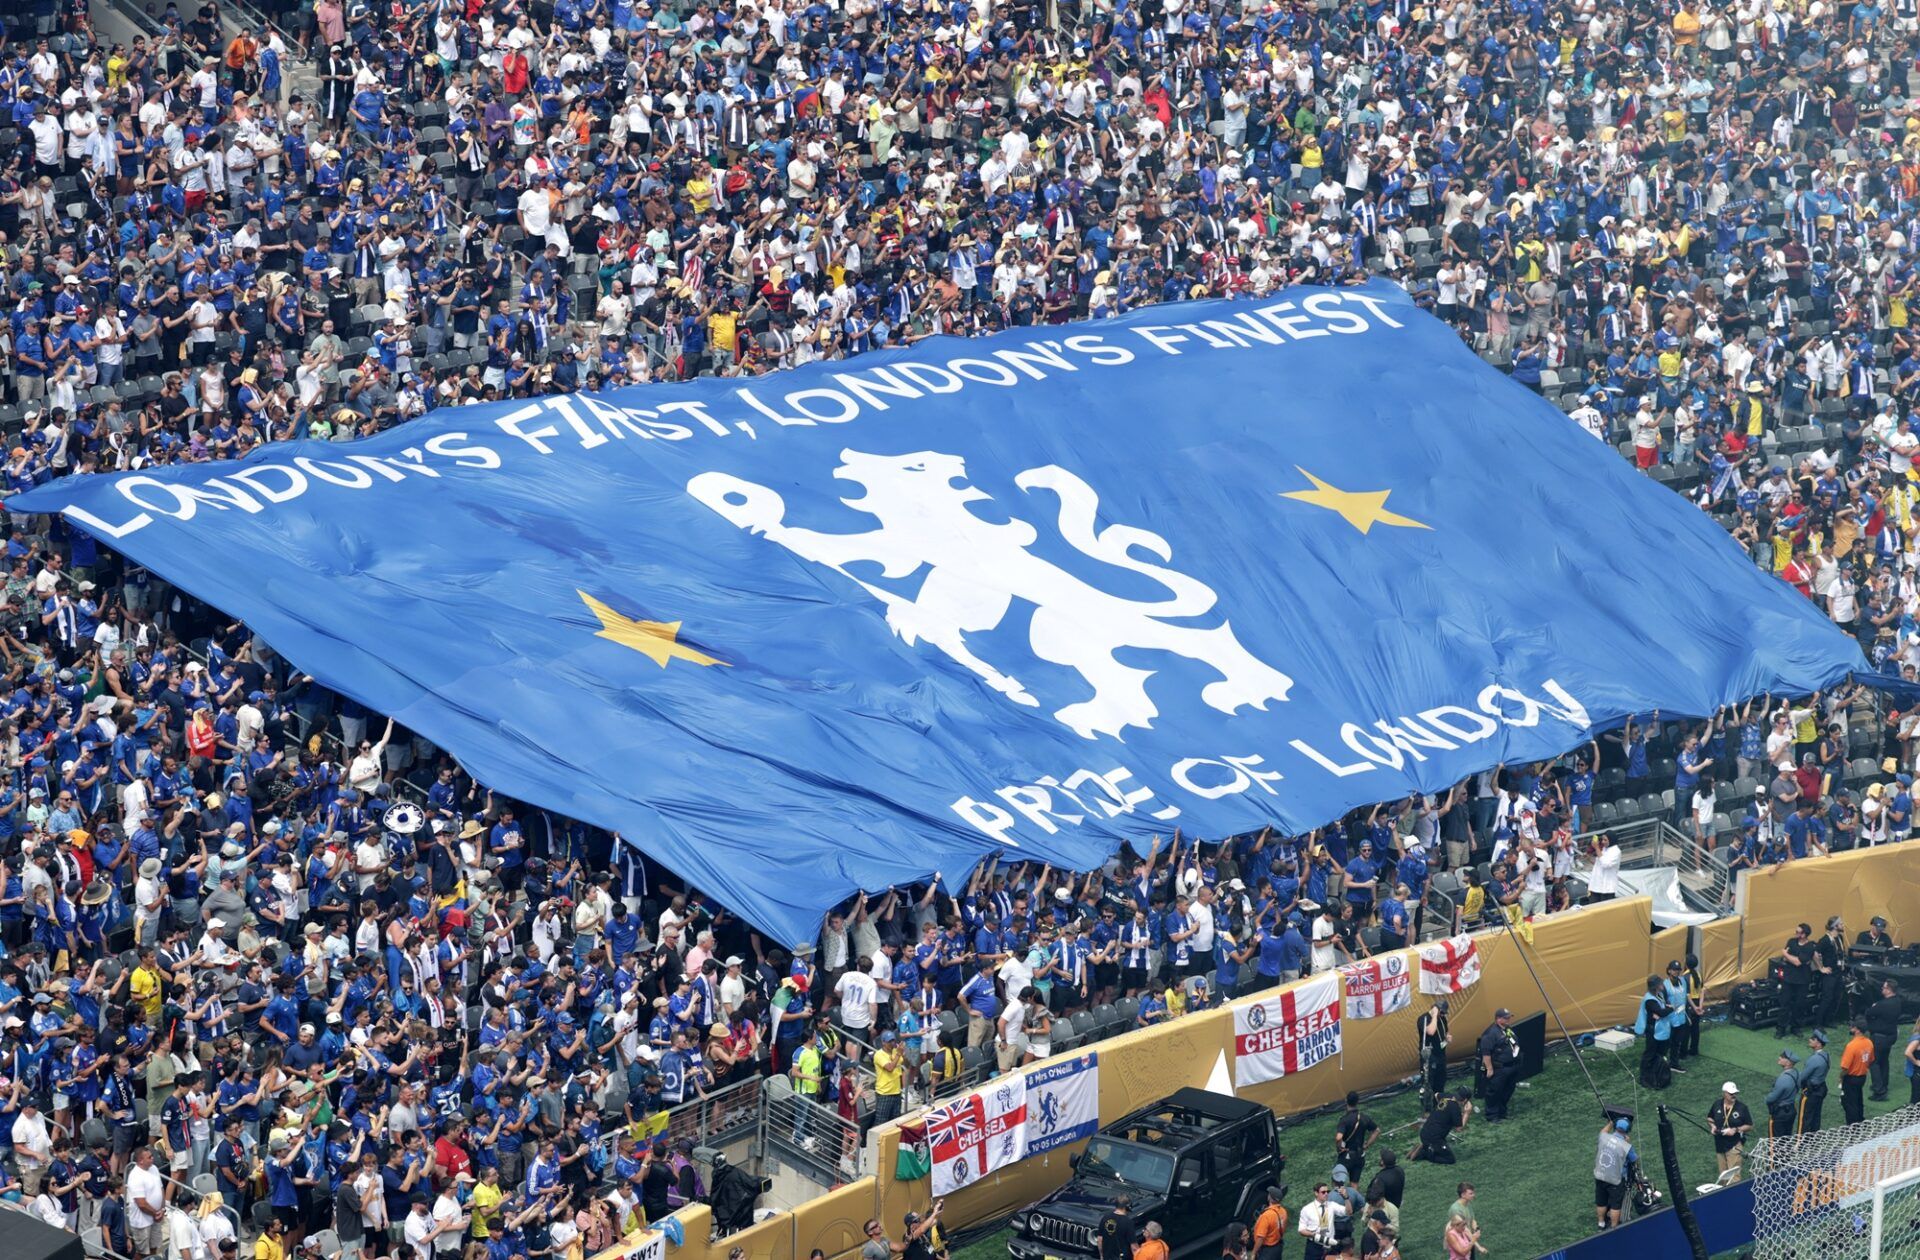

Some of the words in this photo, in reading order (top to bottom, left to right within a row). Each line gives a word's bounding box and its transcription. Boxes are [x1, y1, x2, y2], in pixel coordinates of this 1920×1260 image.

[62, 432, 502, 538] LONDON'S
[494, 391, 756, 454] FIRST,
[736, 335, 1136, 426] LONDON'S
[1136, 291, 1404, 355] FINEST
[1587, 414, 1600, 430] 19
[1171, 753, 1284, 800] OF
[1288, 678, 1592, 777] LONDON
[848, 984, 864, 1005] 11
[1244, 1010, 1334, 1054] CHELSEA
[1298, 1021, 1341, 1055] BARROW
[1303, 1041, 1337, 1067] BLUES
[436, 1092, 461, 1115] 20
[958, 1117, 1007, 1151] CHELSEA
[631, 1242, 659, 1260] SW17
